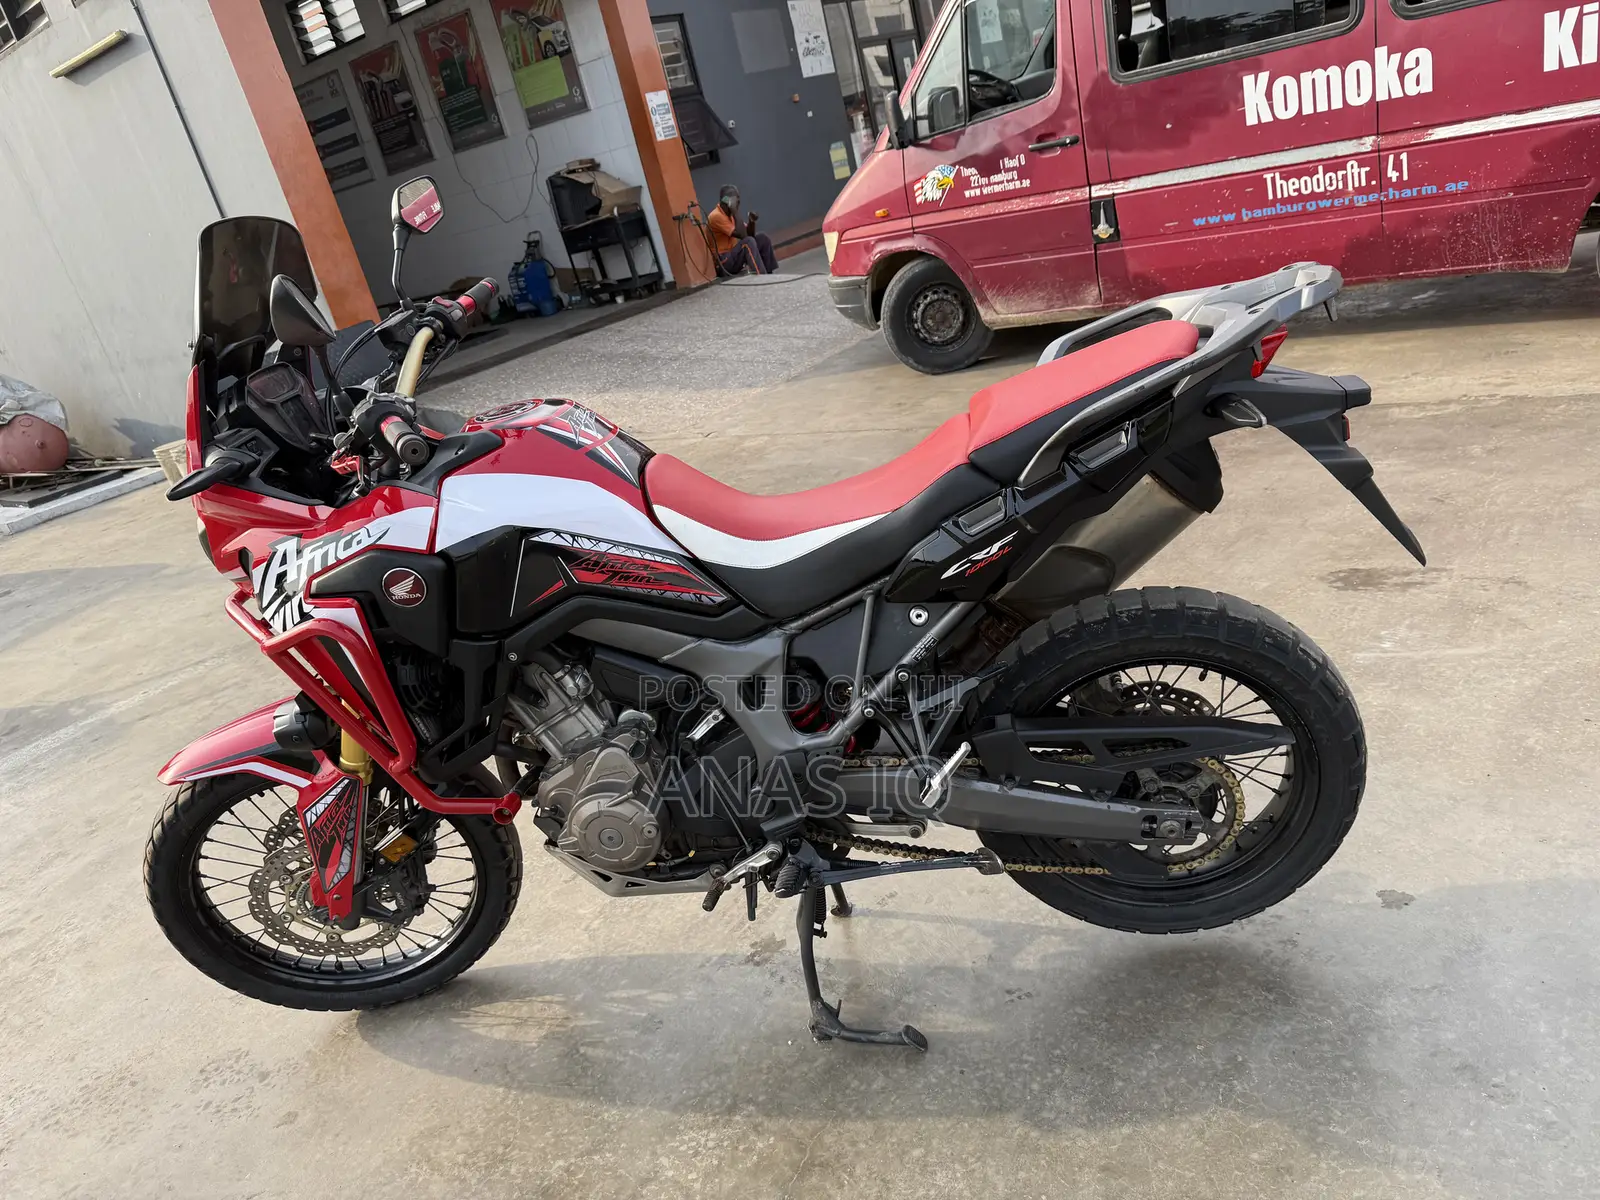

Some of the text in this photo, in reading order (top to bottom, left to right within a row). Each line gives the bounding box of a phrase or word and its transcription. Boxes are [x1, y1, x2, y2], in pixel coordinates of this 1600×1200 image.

[1242, 46, 1434, 126] Komoka
[1386, 151, 1409, 183] 41
[1192, 212, 1237, 226] www
[261, 522, 391, 609] Africa
[940, 530, 1019, 580] CRF
[391, 592, 422, 601] HONDA
